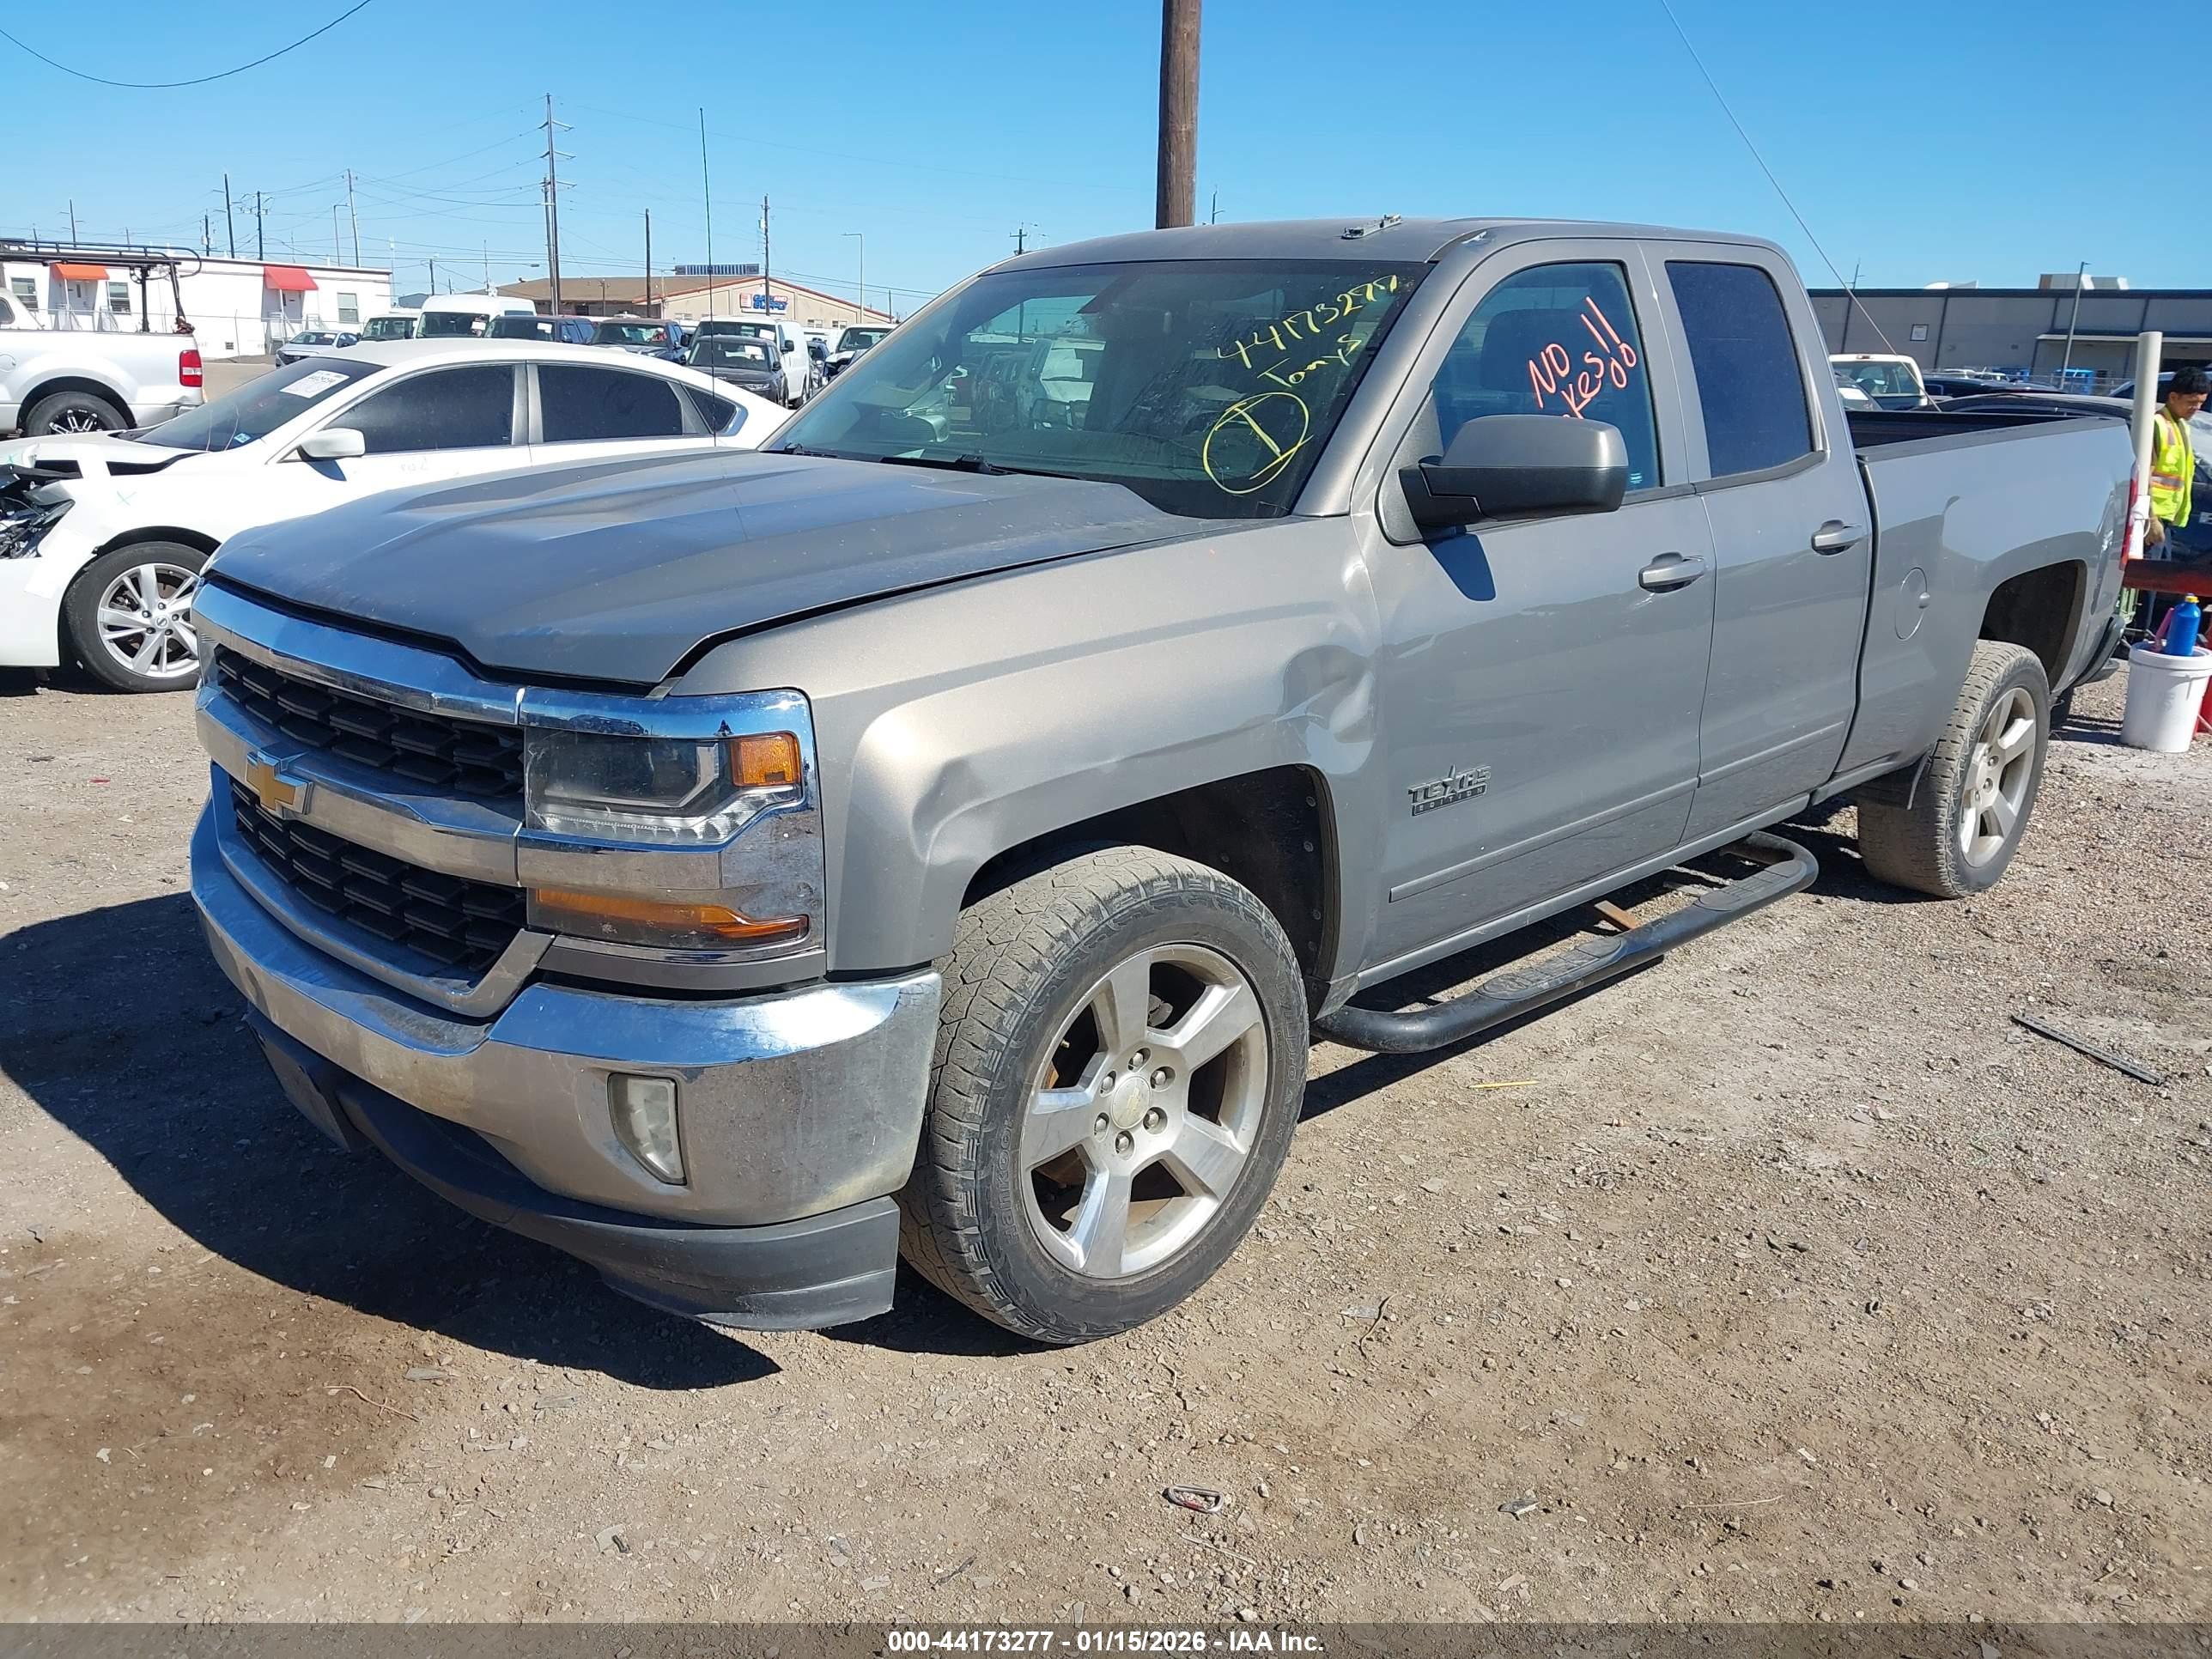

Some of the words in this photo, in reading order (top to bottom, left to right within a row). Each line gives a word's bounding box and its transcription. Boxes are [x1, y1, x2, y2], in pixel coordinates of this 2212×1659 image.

[1528, 343, 1571, 409] NO
[1407, 763, 1492, 804] TEXAS
[1419, 786, 1484, 811] EDITION
